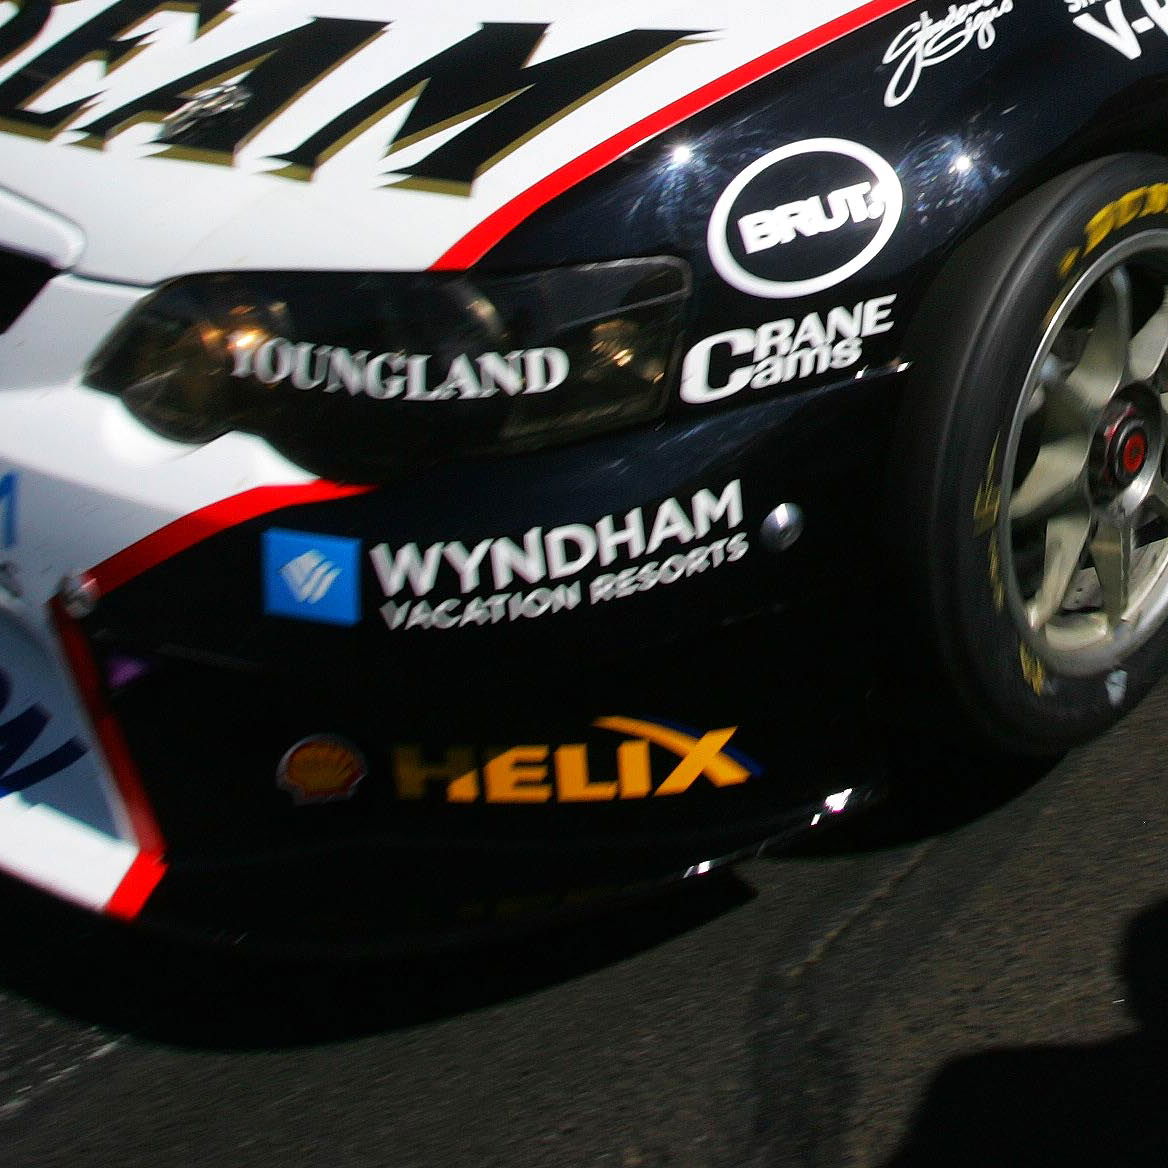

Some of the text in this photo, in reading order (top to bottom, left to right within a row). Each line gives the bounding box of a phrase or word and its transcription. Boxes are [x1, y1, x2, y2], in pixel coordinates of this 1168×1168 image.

[230, 335, 569, 402] YOUNGLAND
[369, 479, 745, 597] WYNDHAM
[380, 532, 748, 630] VACATION RESORTS
[393, 715, 755, 804] HELIX
